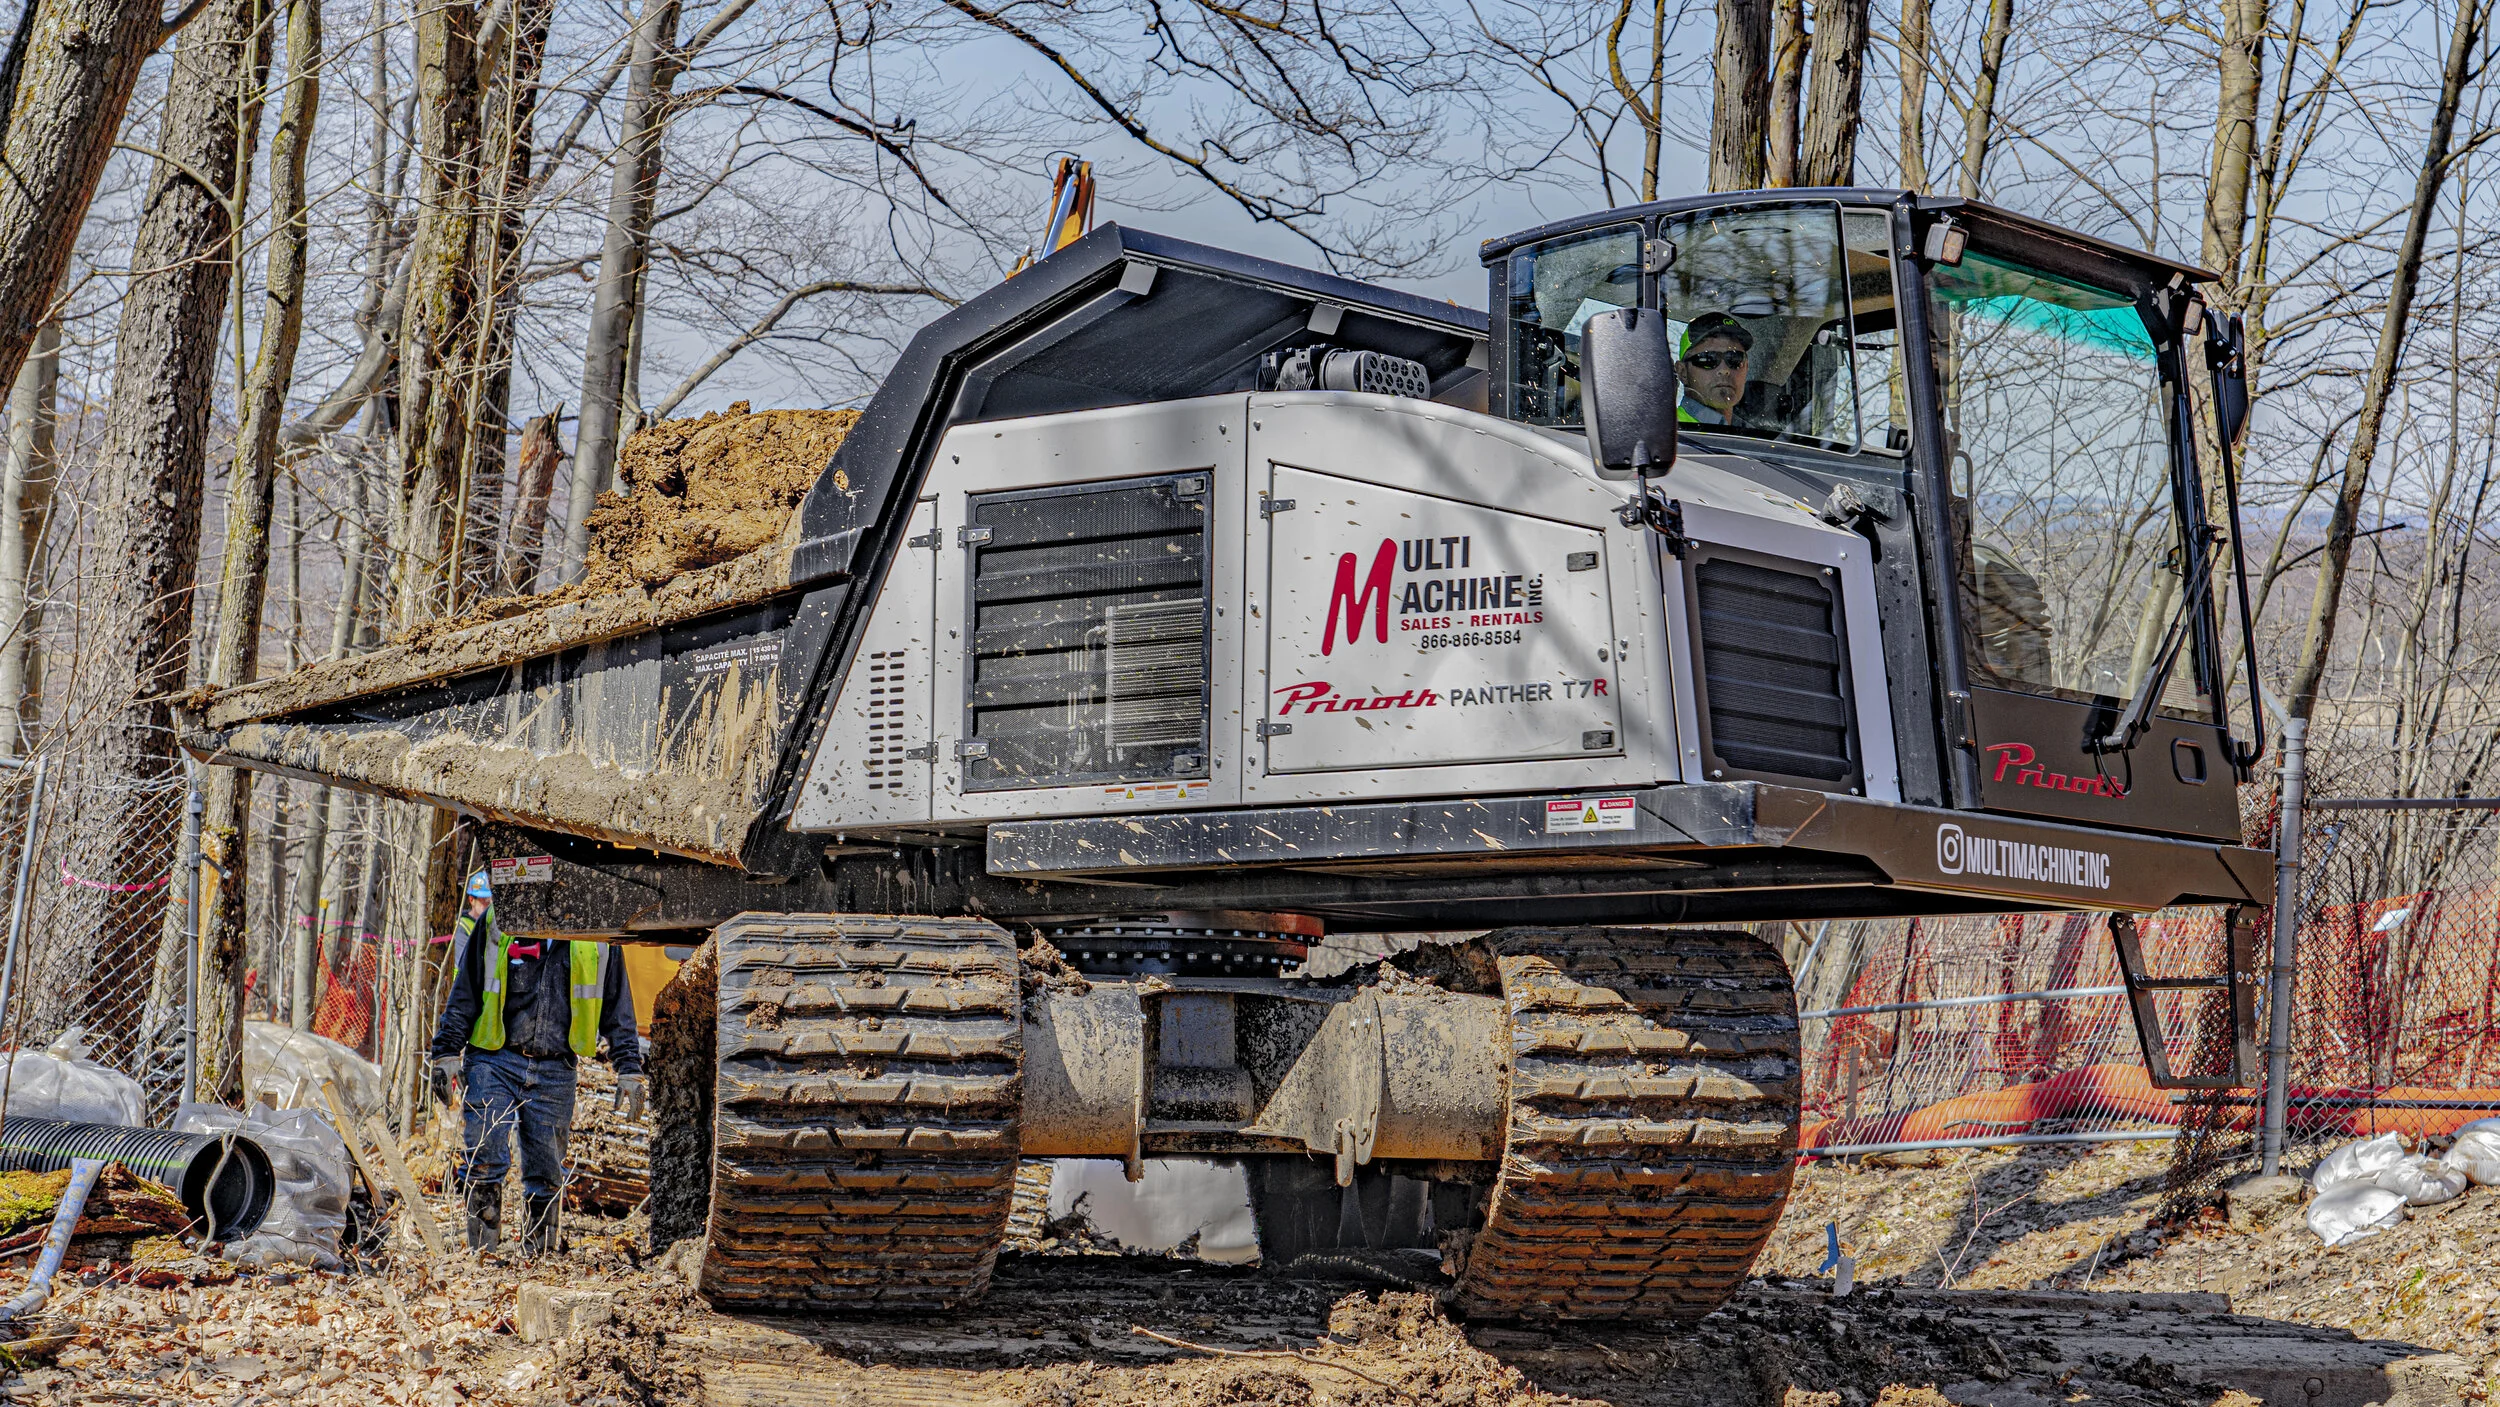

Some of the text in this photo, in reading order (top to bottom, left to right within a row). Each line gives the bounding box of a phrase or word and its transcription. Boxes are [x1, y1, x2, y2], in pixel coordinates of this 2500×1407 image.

[1528, 573, 1544, 607] INC.
[1401, 616, 1451, 631] SALES
[1470, 611, 1544, 627] RENTALS
[695, 658, 748, 673] MAX. CAPAITY
[730, 647, 748, 658] MAX.
[1273, 678, 1608, 716] Prinoth PANTHER T7R
[1984, 741, 2126, 800] Prinoth
[1966, 835, 2111, 890] MULTIMACHINEINC
